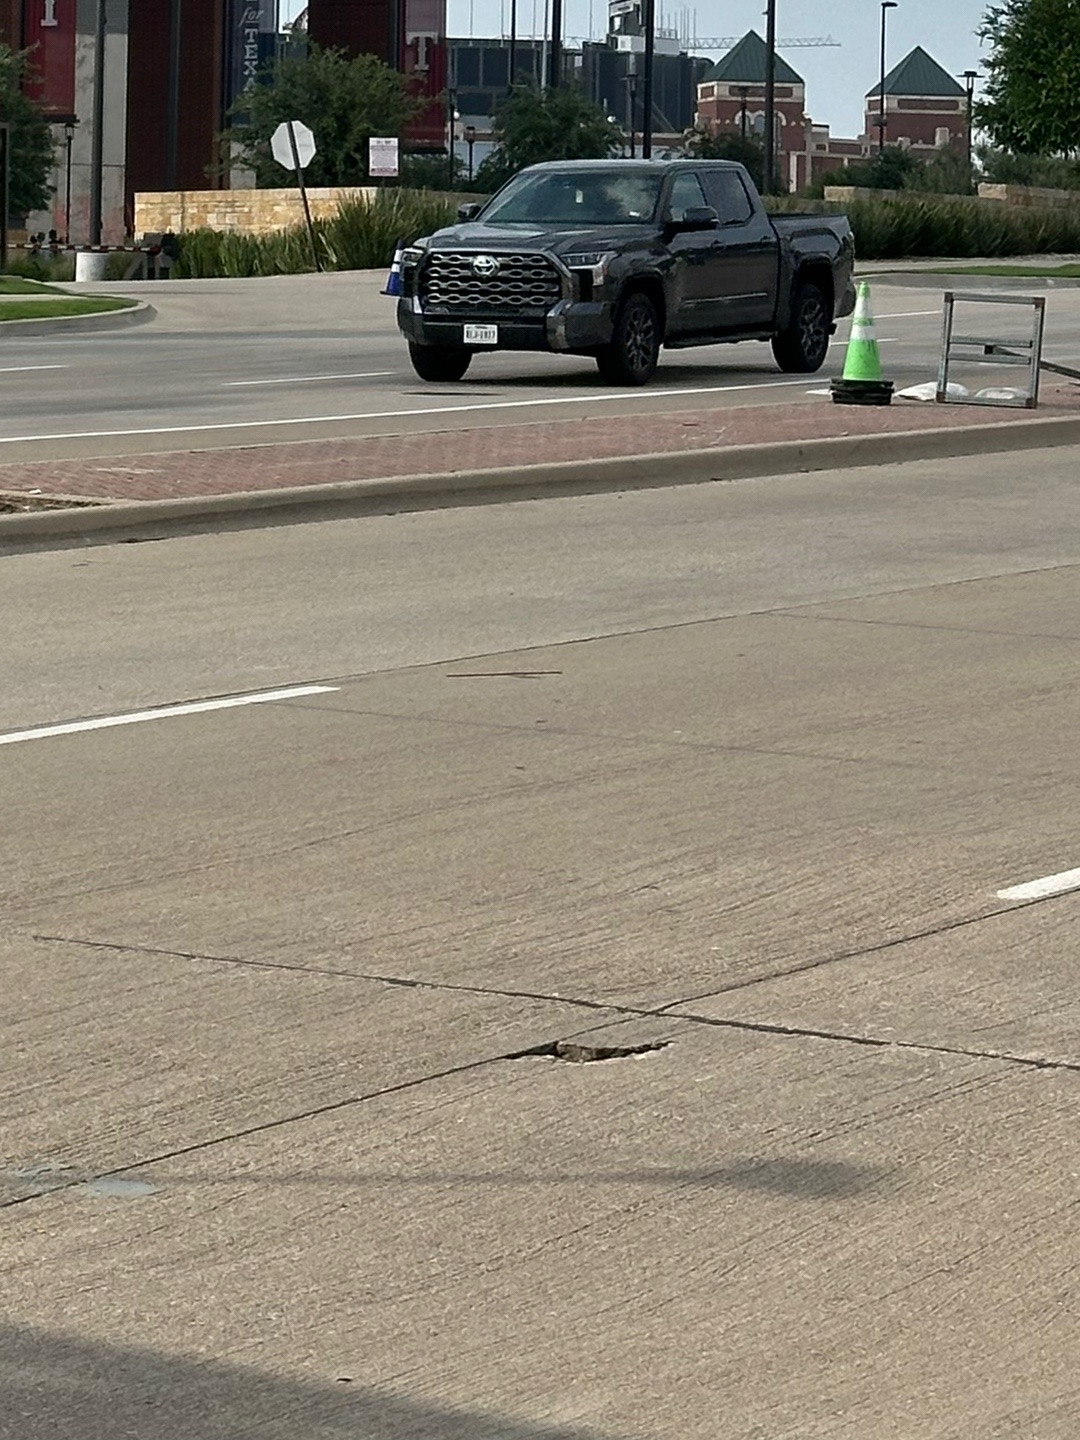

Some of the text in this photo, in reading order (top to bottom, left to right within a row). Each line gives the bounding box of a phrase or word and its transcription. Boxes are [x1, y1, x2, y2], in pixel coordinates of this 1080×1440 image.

[239, 6, 264, 28] for
[242, 28, 259, 94] TEXA
[406, 31, 438, 71] T
